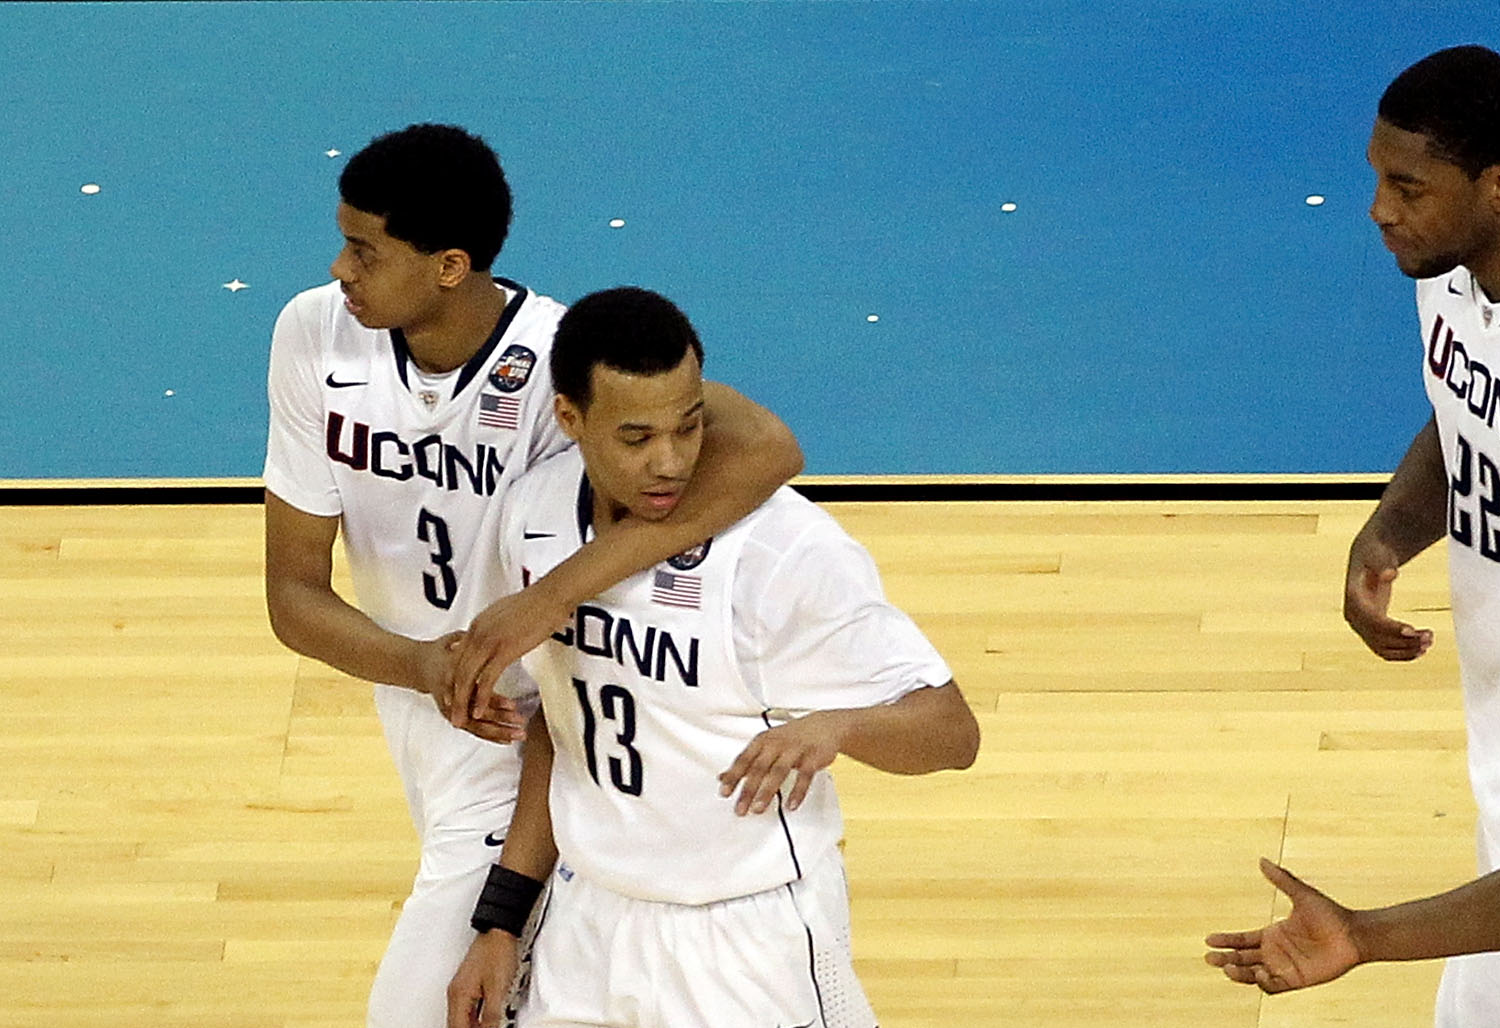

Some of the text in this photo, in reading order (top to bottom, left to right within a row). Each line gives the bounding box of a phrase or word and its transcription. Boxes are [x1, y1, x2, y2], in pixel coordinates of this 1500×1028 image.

[417, 507, 458, 611] 3
[522, 566, 699, 688] ONN
[573, 677, 643, 797] 13
